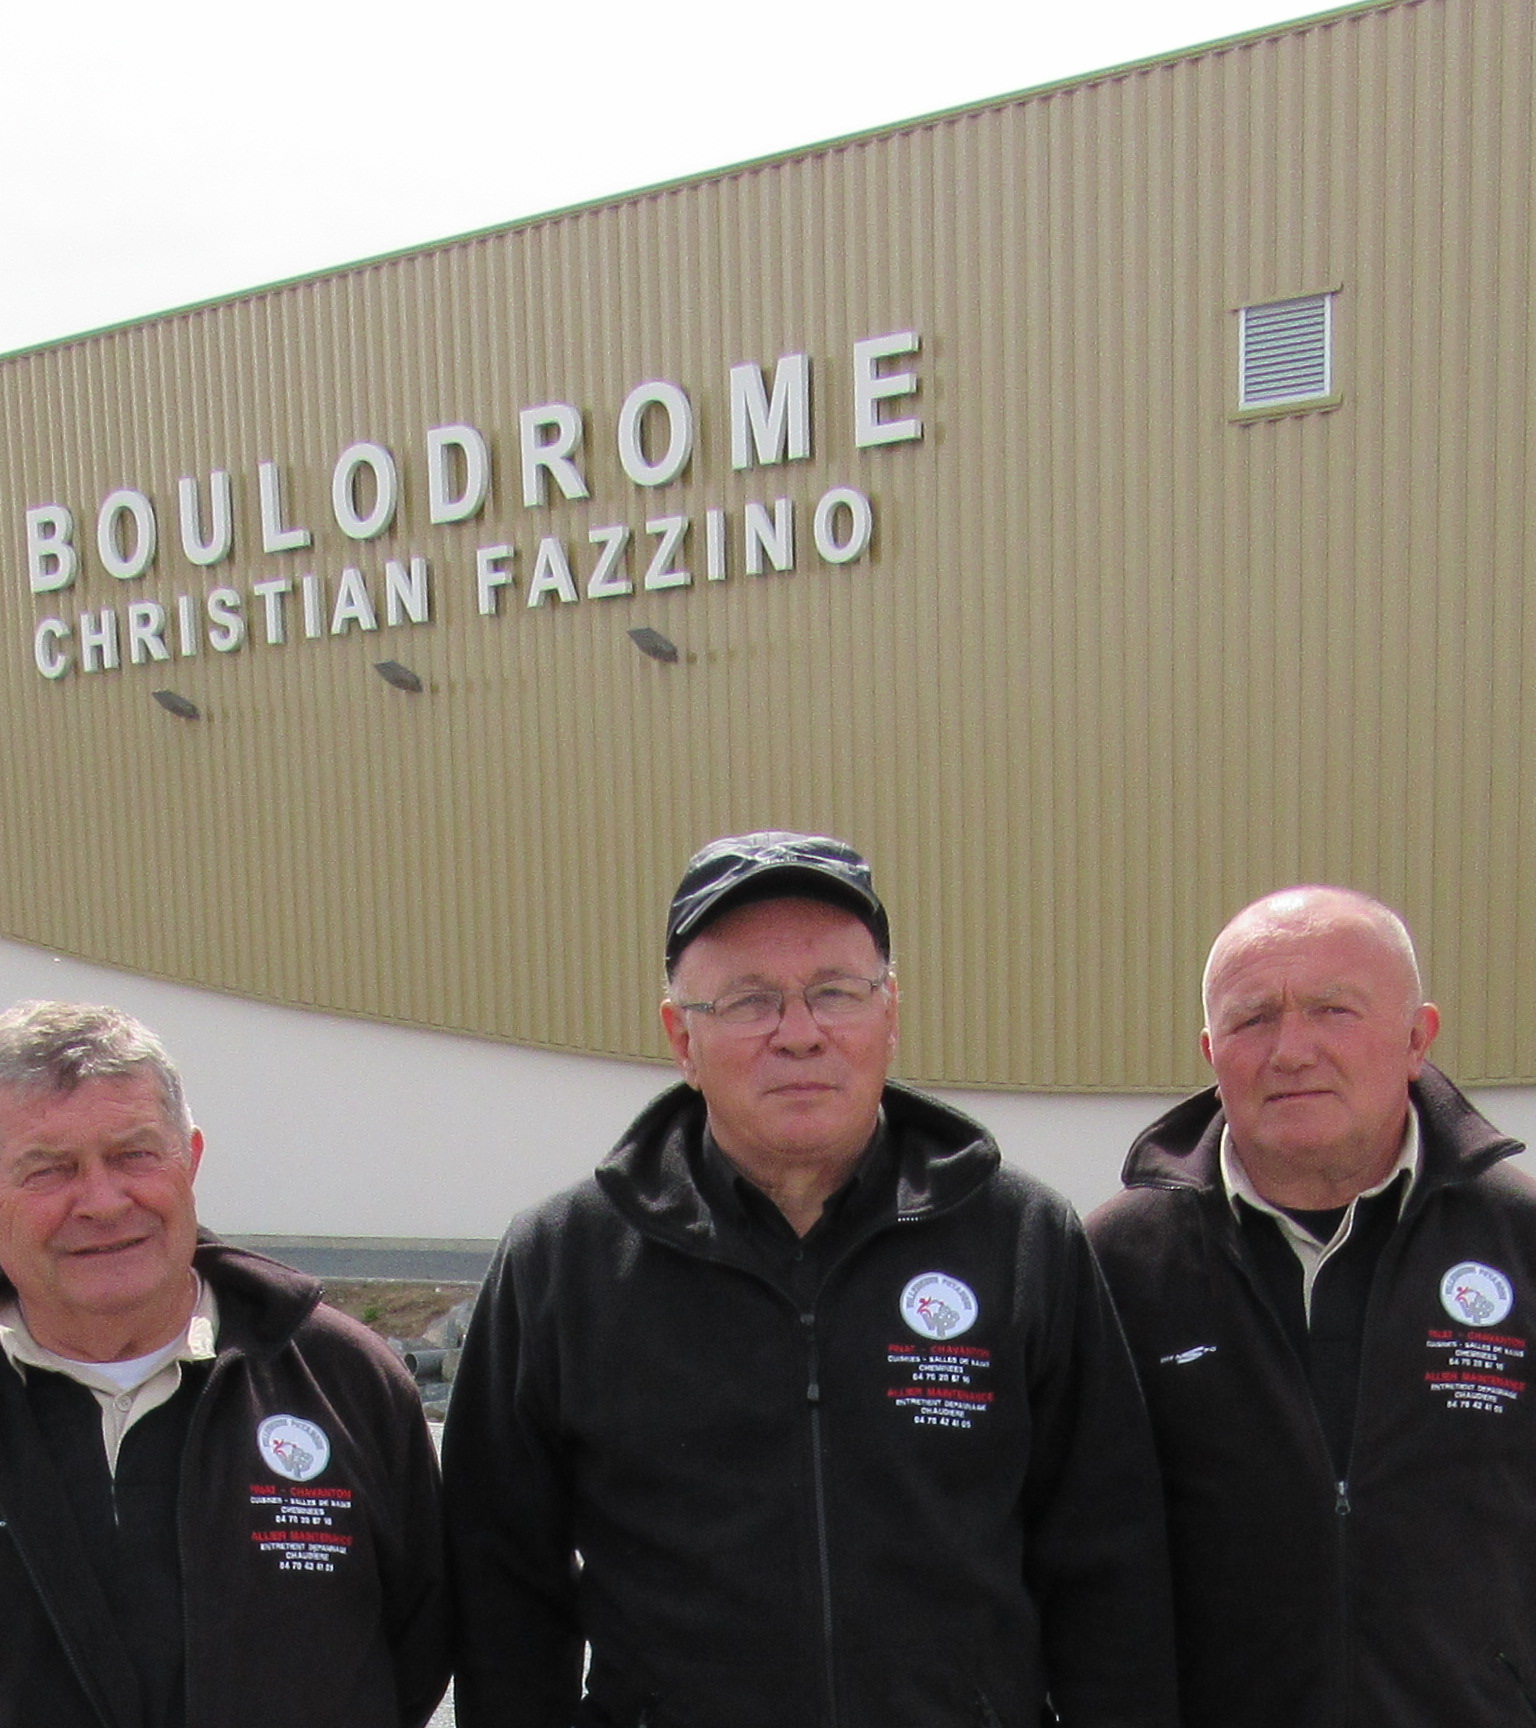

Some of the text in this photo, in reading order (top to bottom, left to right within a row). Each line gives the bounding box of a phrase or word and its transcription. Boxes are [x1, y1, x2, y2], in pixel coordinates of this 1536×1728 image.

[26, 330, 924, 593] BOULODROME
[34, 486, 875, 679] CHRISTIAN FAZZINO
[959, 1357, 969, 1365] DE
